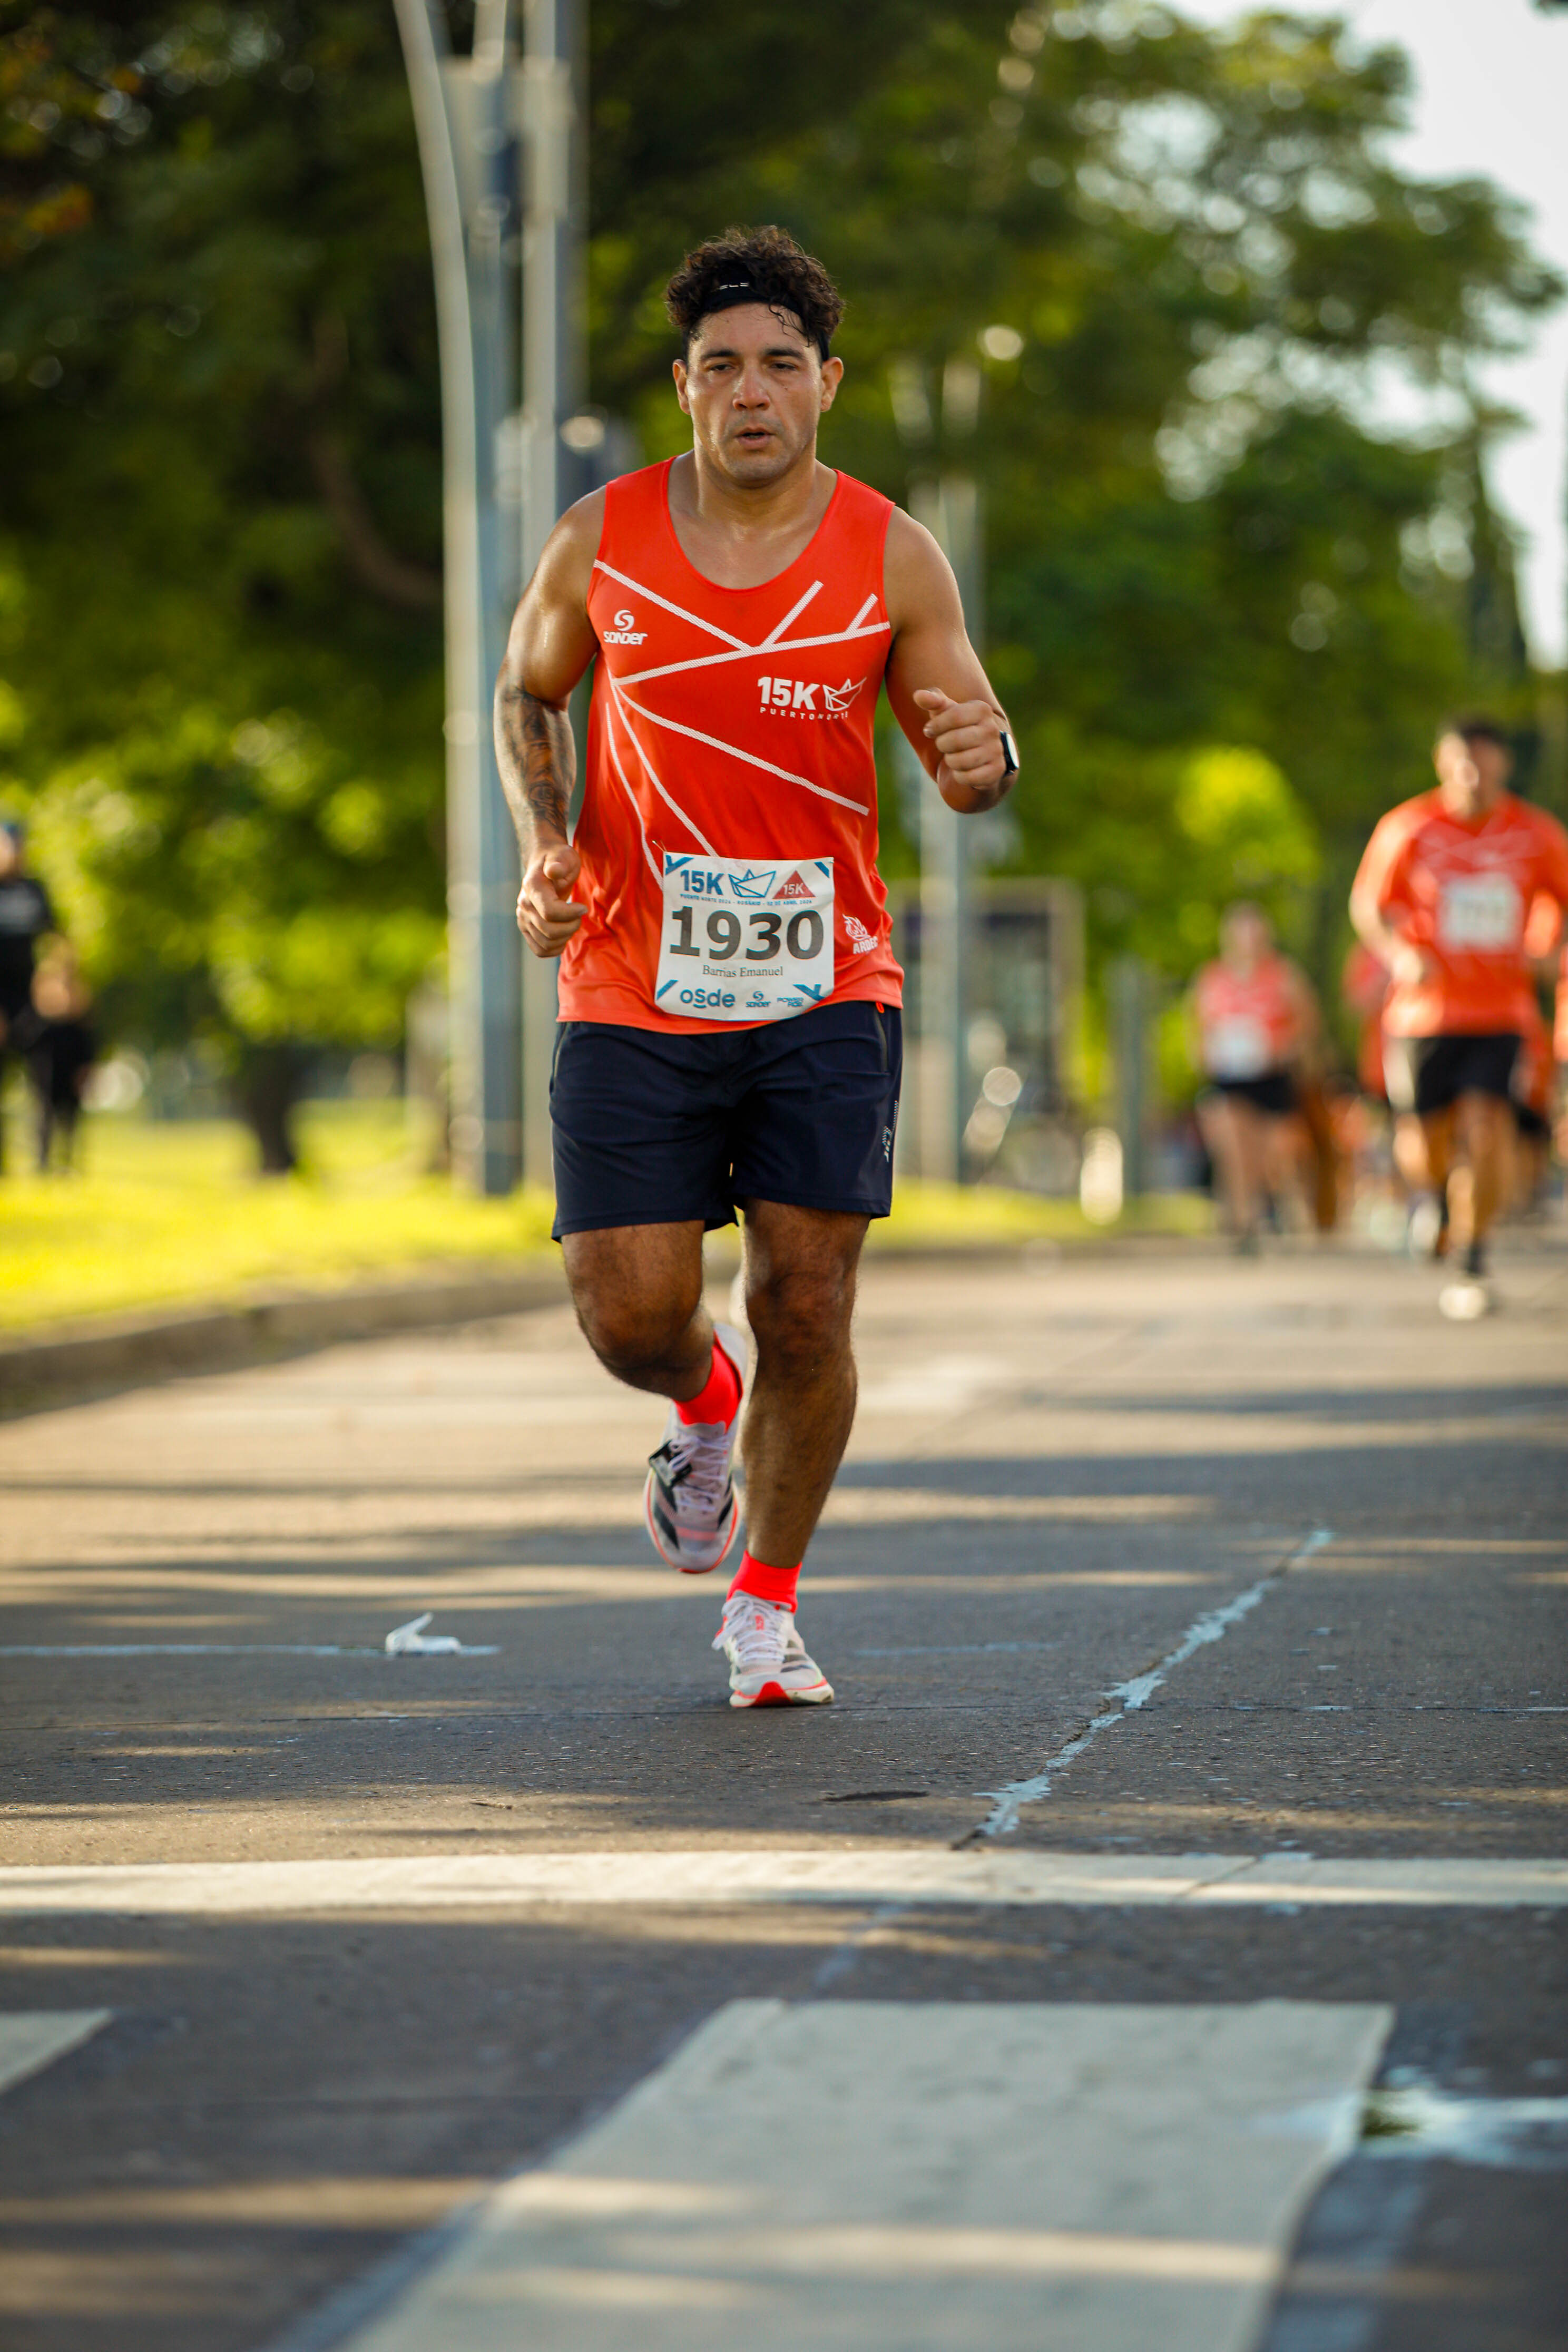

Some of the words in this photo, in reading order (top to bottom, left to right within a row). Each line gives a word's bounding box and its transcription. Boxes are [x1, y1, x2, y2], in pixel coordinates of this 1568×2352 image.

[758, 677, 820, 710] 15K
[680, 869, 724, 896] 15K
[783, 884, 805, 895] 15K
[670, 906, 824, 961] 1930
[740, 965, 783, 977] Emanuel
[680, 988, 736, 1008] osde
